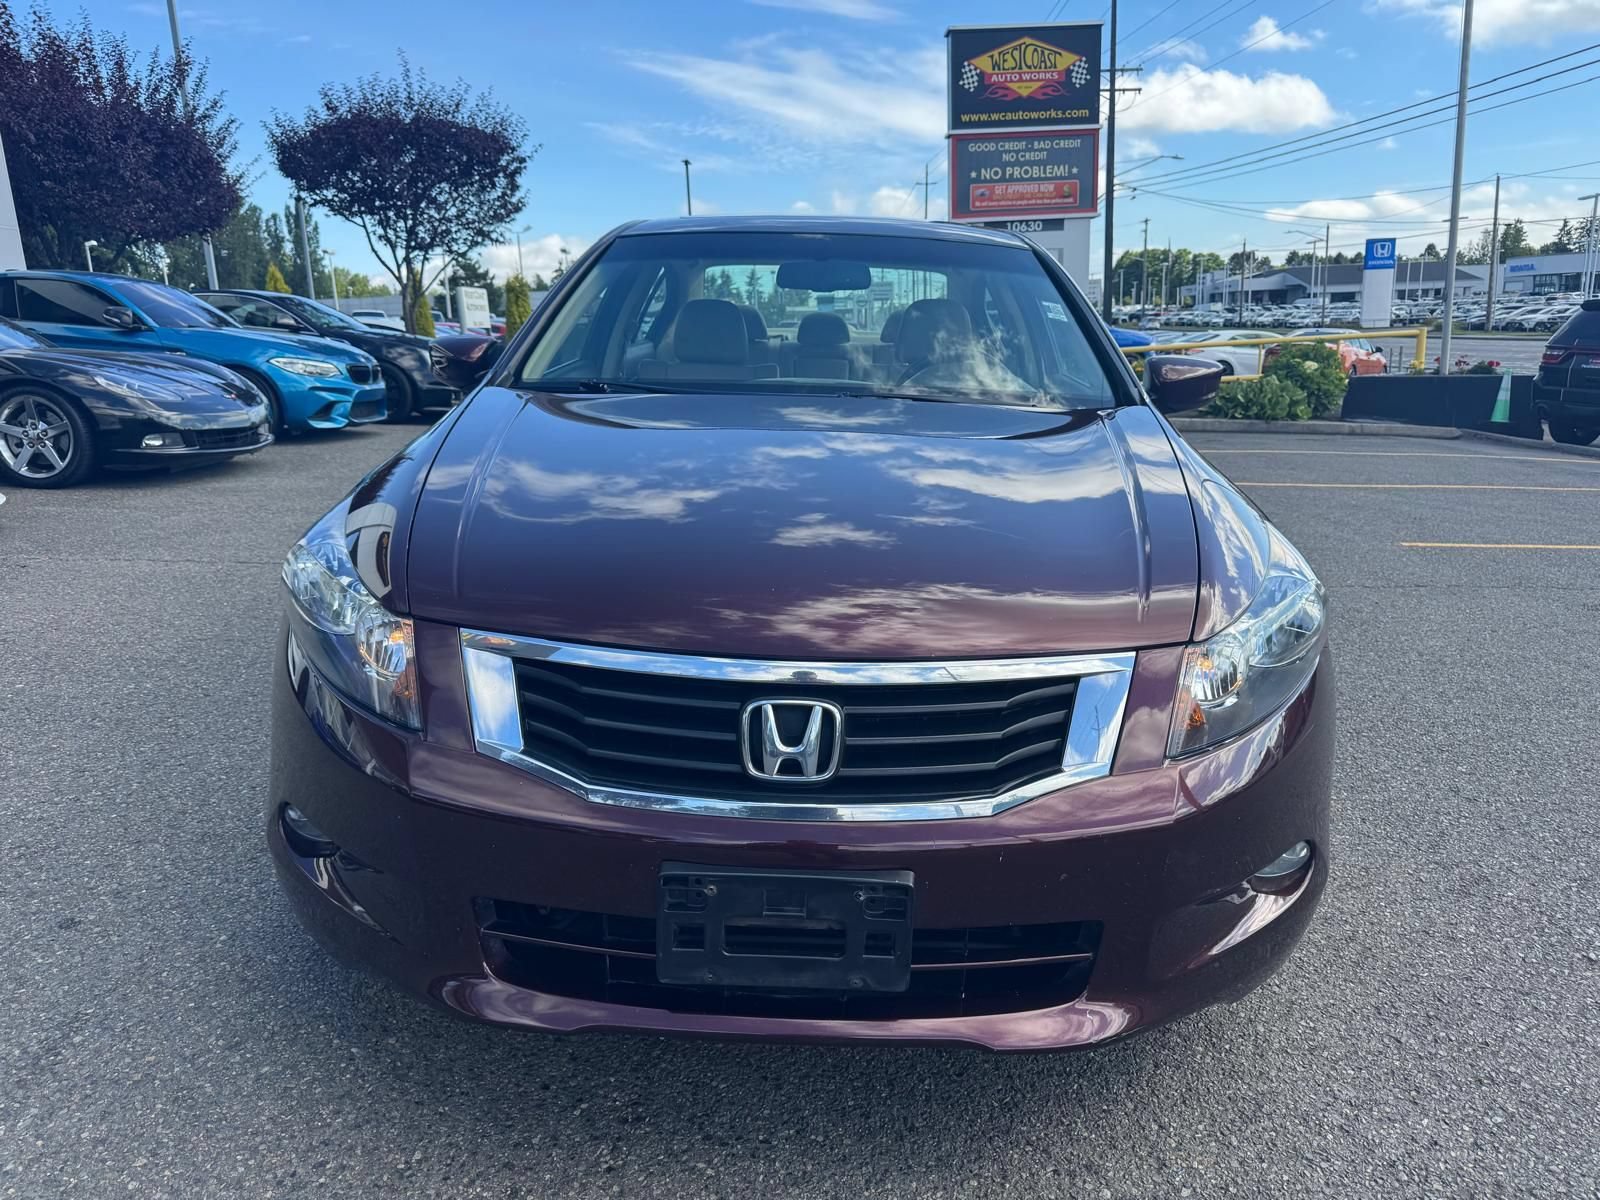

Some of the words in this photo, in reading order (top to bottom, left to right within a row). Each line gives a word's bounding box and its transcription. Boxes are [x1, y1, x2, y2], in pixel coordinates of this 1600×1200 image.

[991, 74, 1019, 82] AUTO
[1022, 72, 1058, 80] WORKS
[961, 108, 1089, 123] www.wcautoworks.com
[968, 143, 996, 152] GOOD
[998, 142, 1026, 150] CREDIT
[1033, 140, 1051, 149] BAD
[1053, 139, 1081, 148] CREDIT
[1002, 153, 1017, 162] NO
[1018, 151, 1047, 161] CREDIT
[981, 167, 1002, 180] NO
[1006, 164, 1068, 179] PROBLEM!
[994, 185, 1007, 194] GET
[1007, 184, 1039, 193] APPROVED
[1040, 183, 1055, 192] NOW
[1006, 221, 1042, 232] 10630
